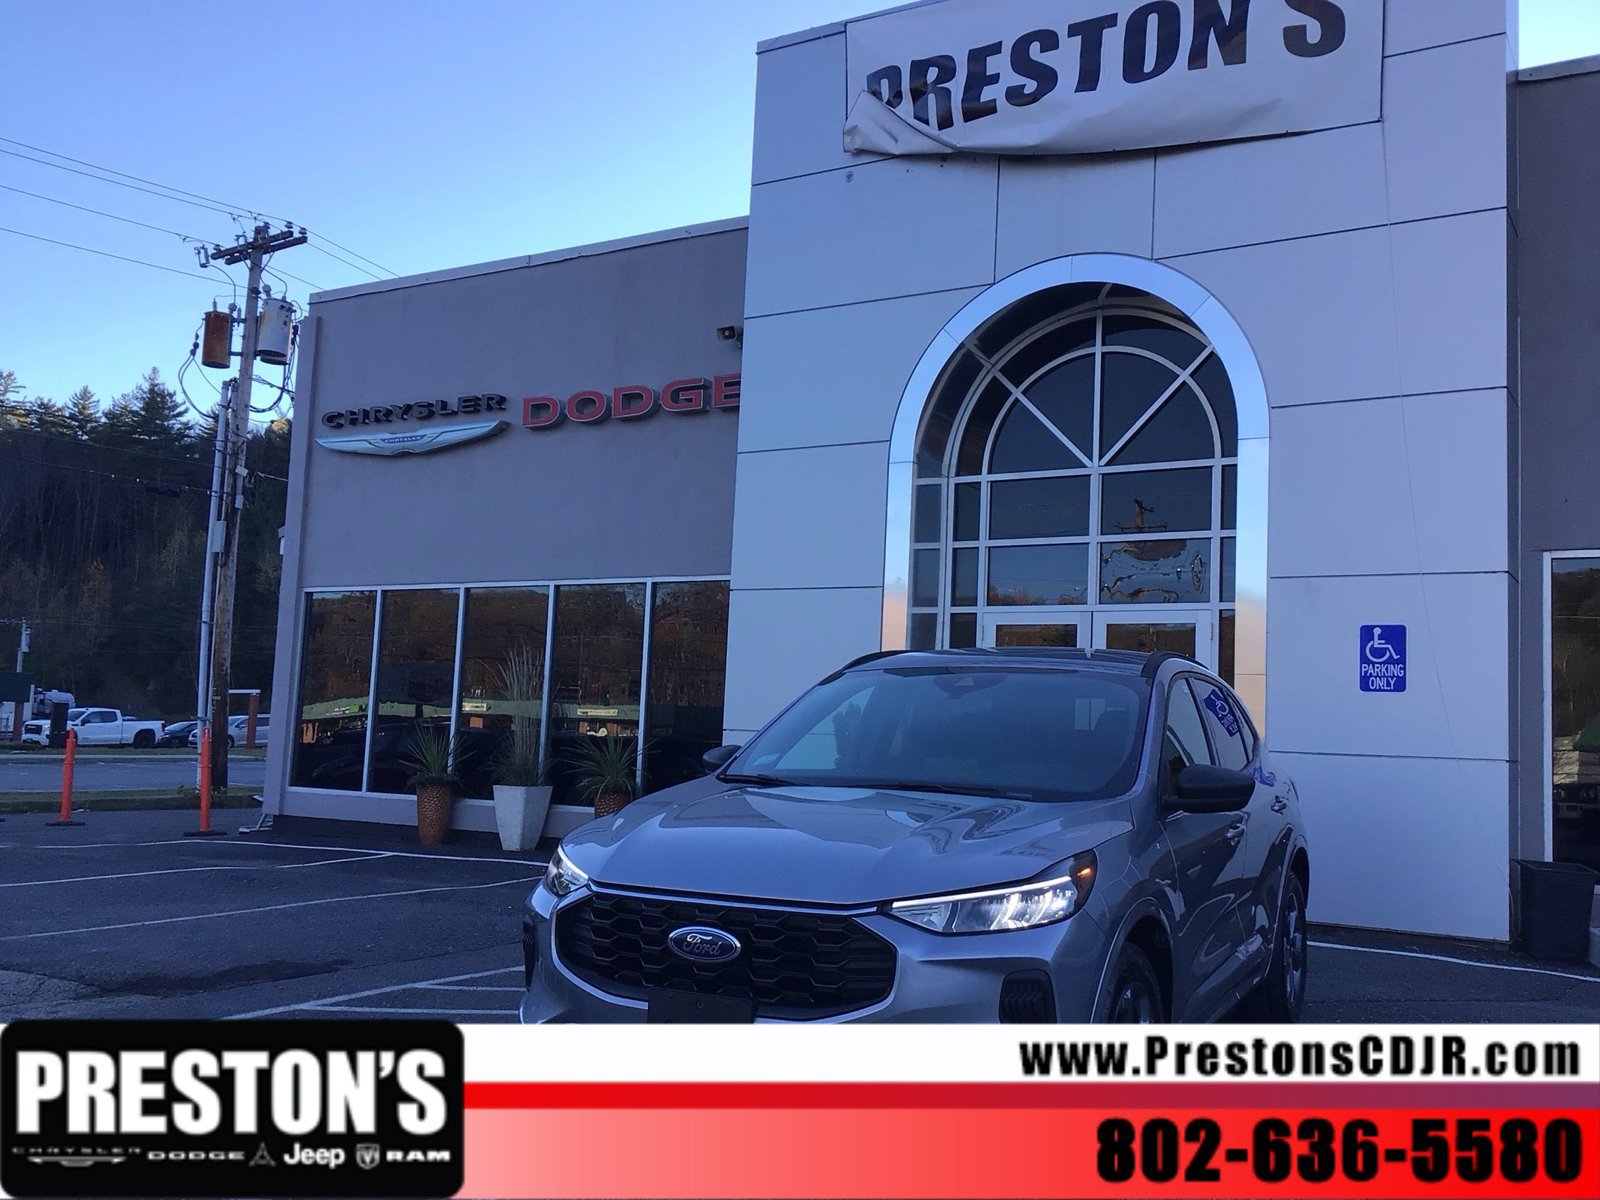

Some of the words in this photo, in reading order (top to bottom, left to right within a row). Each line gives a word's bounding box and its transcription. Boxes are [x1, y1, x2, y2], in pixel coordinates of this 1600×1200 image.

[866, 0, 1347, 131] PRESTONS
[321, 393, 507, 428] CHRYSLER
[521, 373, 741, 429] DODGE
[1361, 663, 1405, 677] PARKING
[1368, 676, 1397, 690] ONLY
[683, 933, 722, 955] Ford
